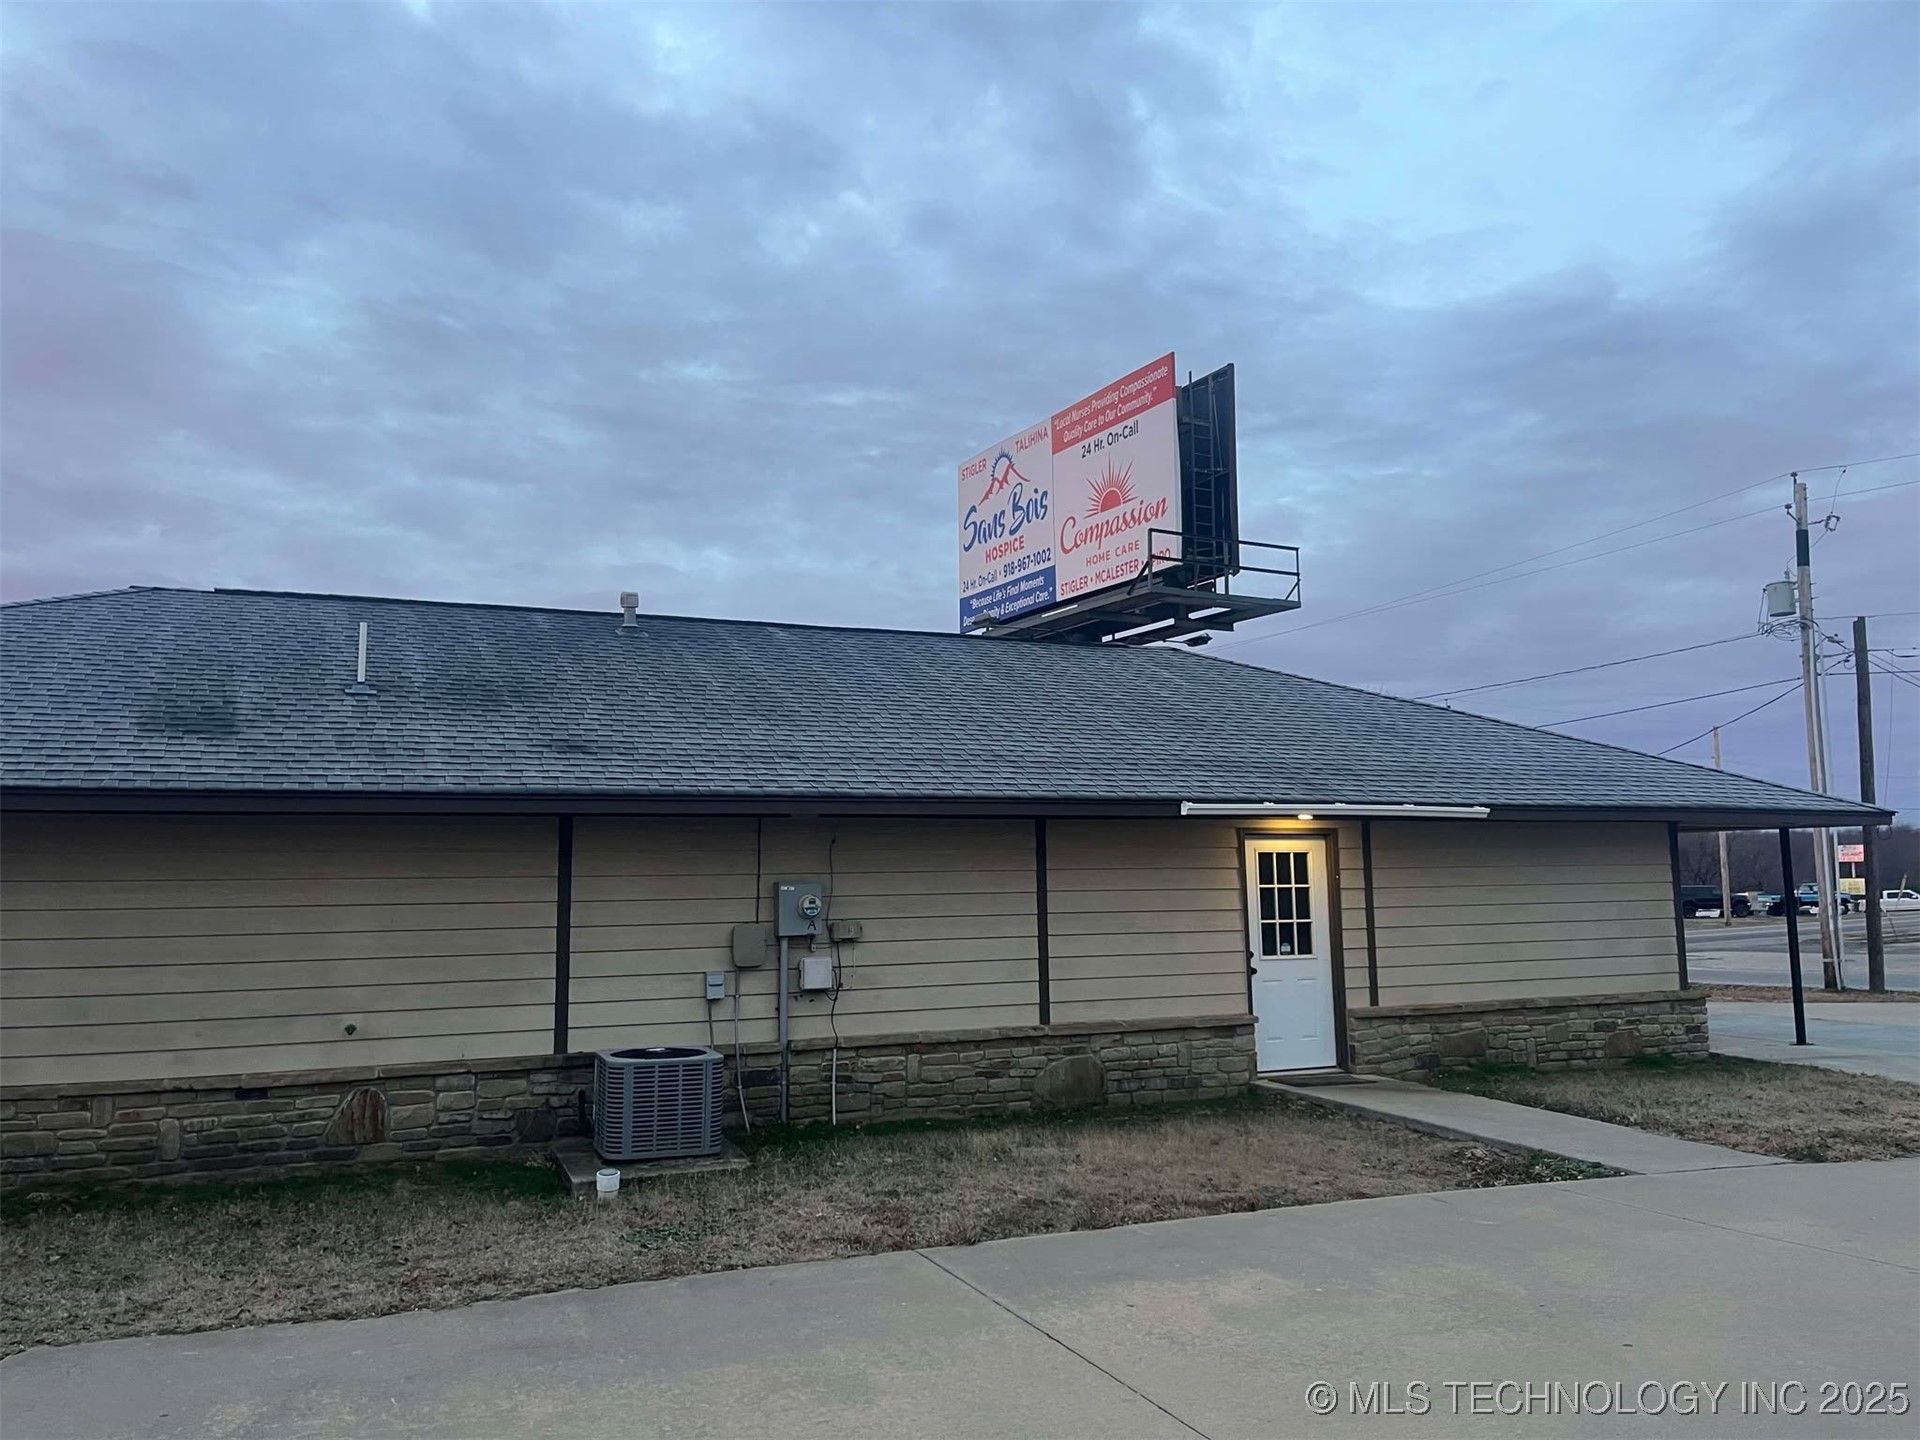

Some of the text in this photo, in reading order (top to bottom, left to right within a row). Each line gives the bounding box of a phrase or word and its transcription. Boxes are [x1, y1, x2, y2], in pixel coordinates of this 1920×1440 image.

[1071, 404, 1091, 421] Nurses
[1091, 389, 1119, 412] Providing
[1120, 365, 1169, 398] Compassionate
[1015, 426, 1049, 453] TALIHINA
[1063, 423, 1084, 443] Quality
[1084, 419, 1097, 433] Care
[1098, 414, 1105, 426] to
[1105, 408, 1117, 423] Our
[1081, 419, 1139, 459] 24 Hr. On-Call
[961, 458, 987, 482] STIGLER
[963, 482, 1048, 552] Sans Bois
[1060, 497, 1168, 555] Compassion
[985, 535, 1025, 564] HOSPICE
[1085, 539, 1140, 568] HOME CARE
[963, 580, 969, 593] 24
[978, 568, 998, 588] On-Call
[1003, 547, 1052, 578] 918-967-1002
[1060, 576, 1089, 597] STIGLER
[1095, 558, 1139, 585] MCALESTER
[992, 588, 1006, 603] Life's
[1006, 582, 1020, 599] Final
[1020, 575, 1045, 594] Moments
[1005, 592, 1035, 614] Exceptional
